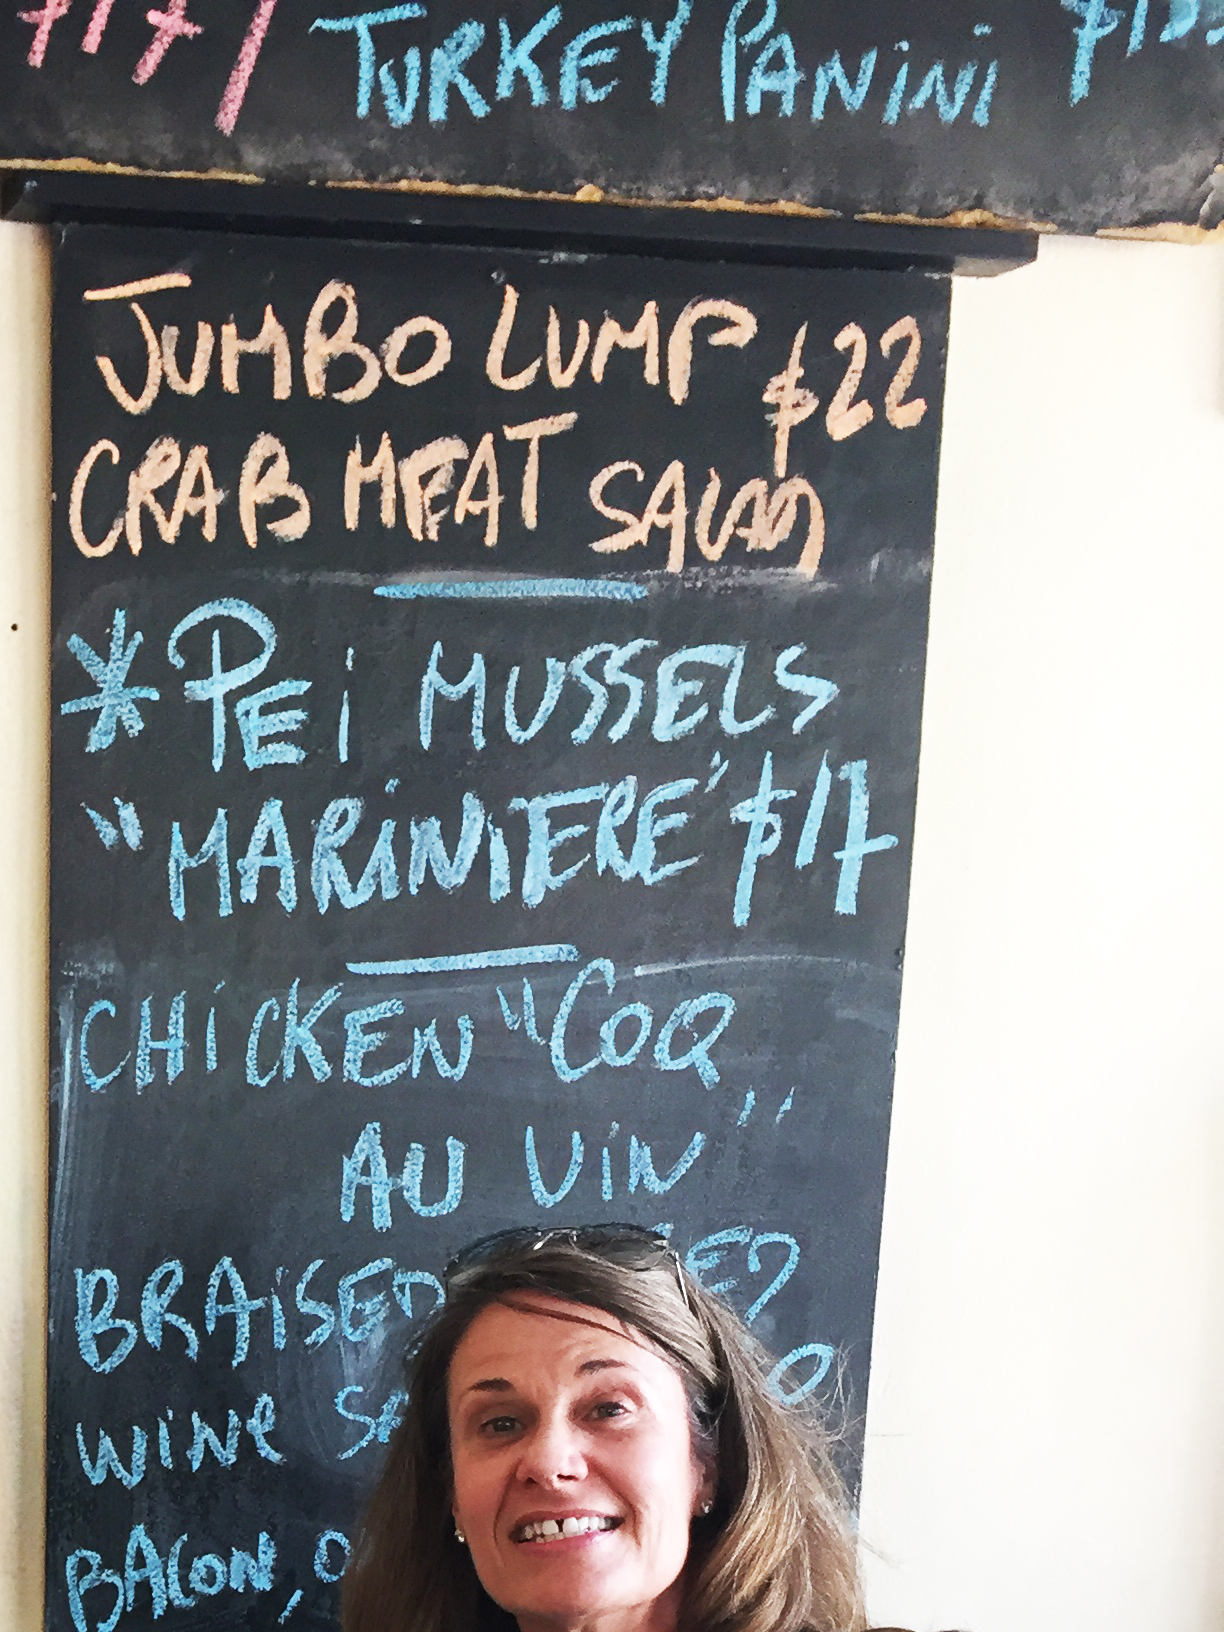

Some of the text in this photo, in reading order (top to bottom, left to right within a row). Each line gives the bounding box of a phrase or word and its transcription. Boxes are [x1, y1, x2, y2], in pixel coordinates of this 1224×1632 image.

[308, 0, 691, 128] TURKEY
[83, 272, 929, 478] JUMBO LUMP $22
[68, 433, 312, 559] CRAB
[343, 412, 579, 548] MEAT
[419, 637, 841, 751] MUSSELS
[730, 748, 899, 928] $17
[340, 1120, 468, 1233] AU
